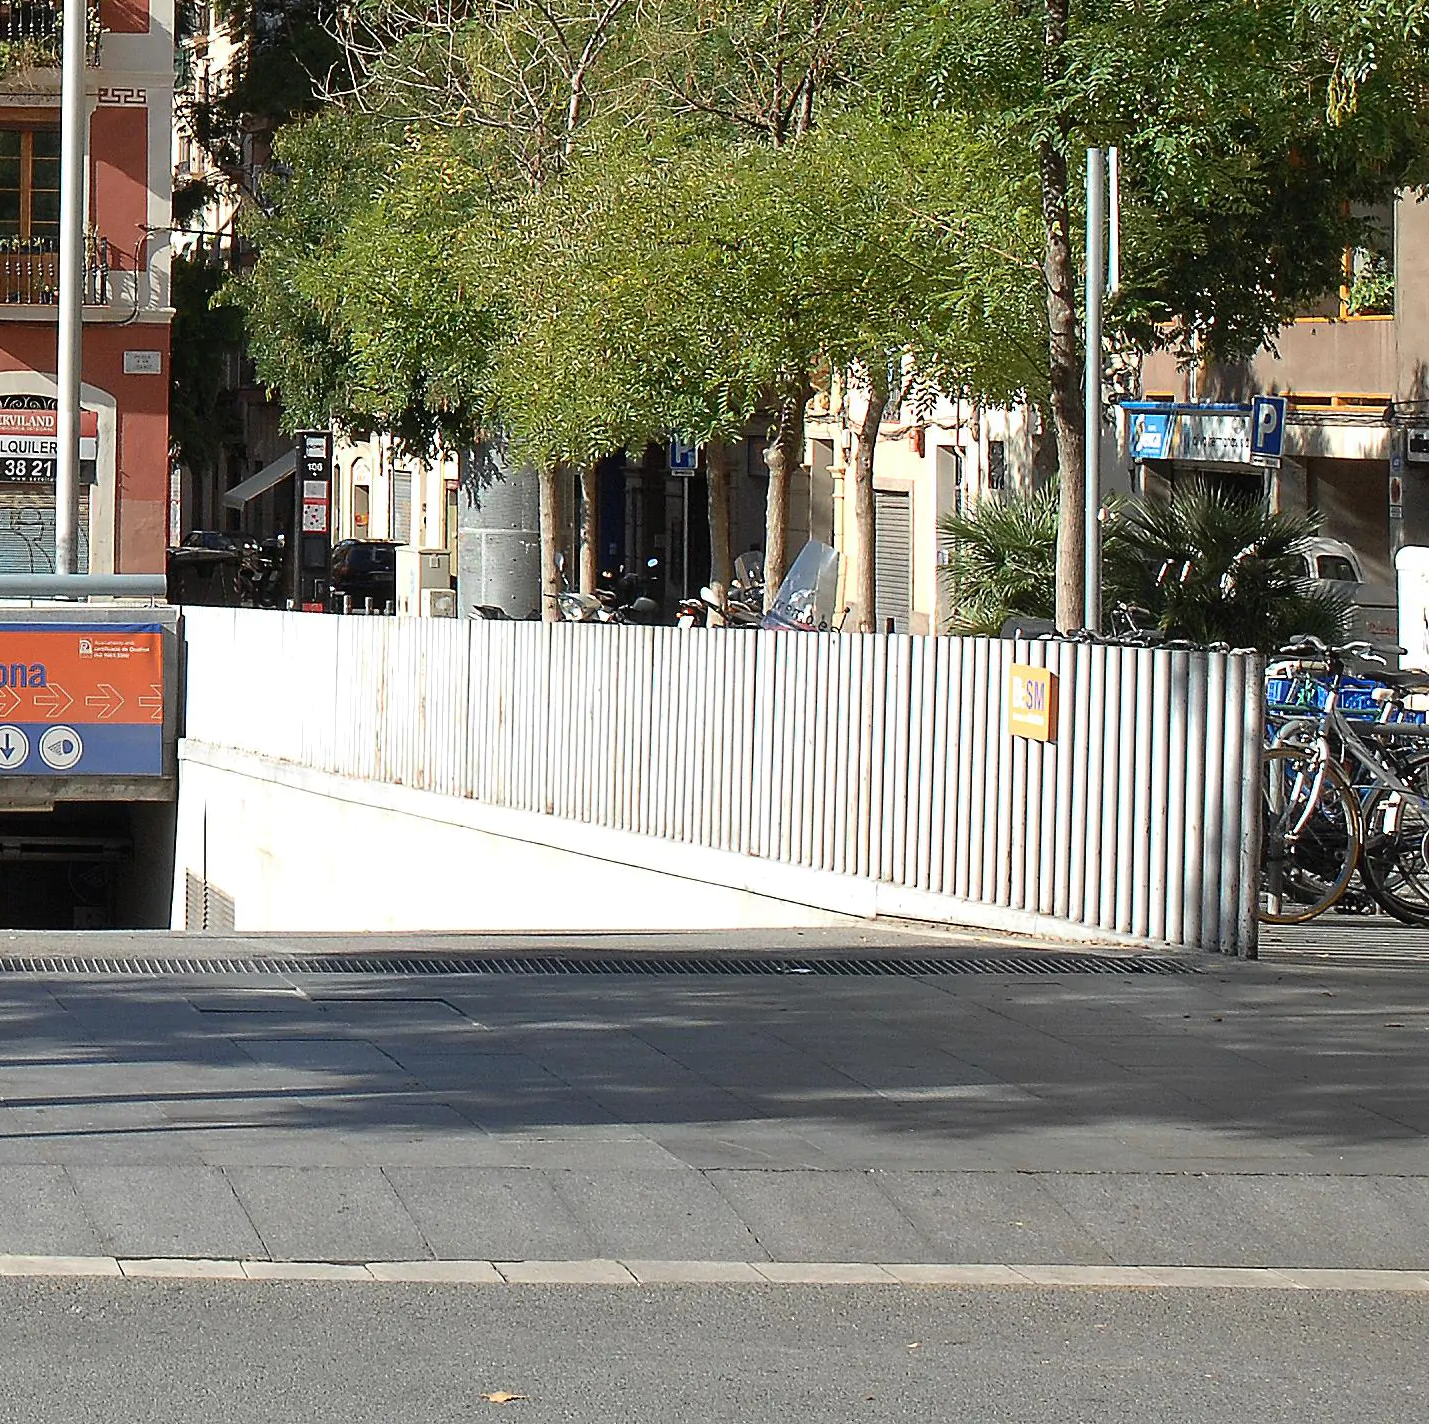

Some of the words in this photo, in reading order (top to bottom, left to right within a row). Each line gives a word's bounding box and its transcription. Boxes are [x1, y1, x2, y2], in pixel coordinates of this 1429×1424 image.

[1257, 403, 1278, 448] P
[4, 459, 26, 476] 38
[31, 460, 52, 477] 21
